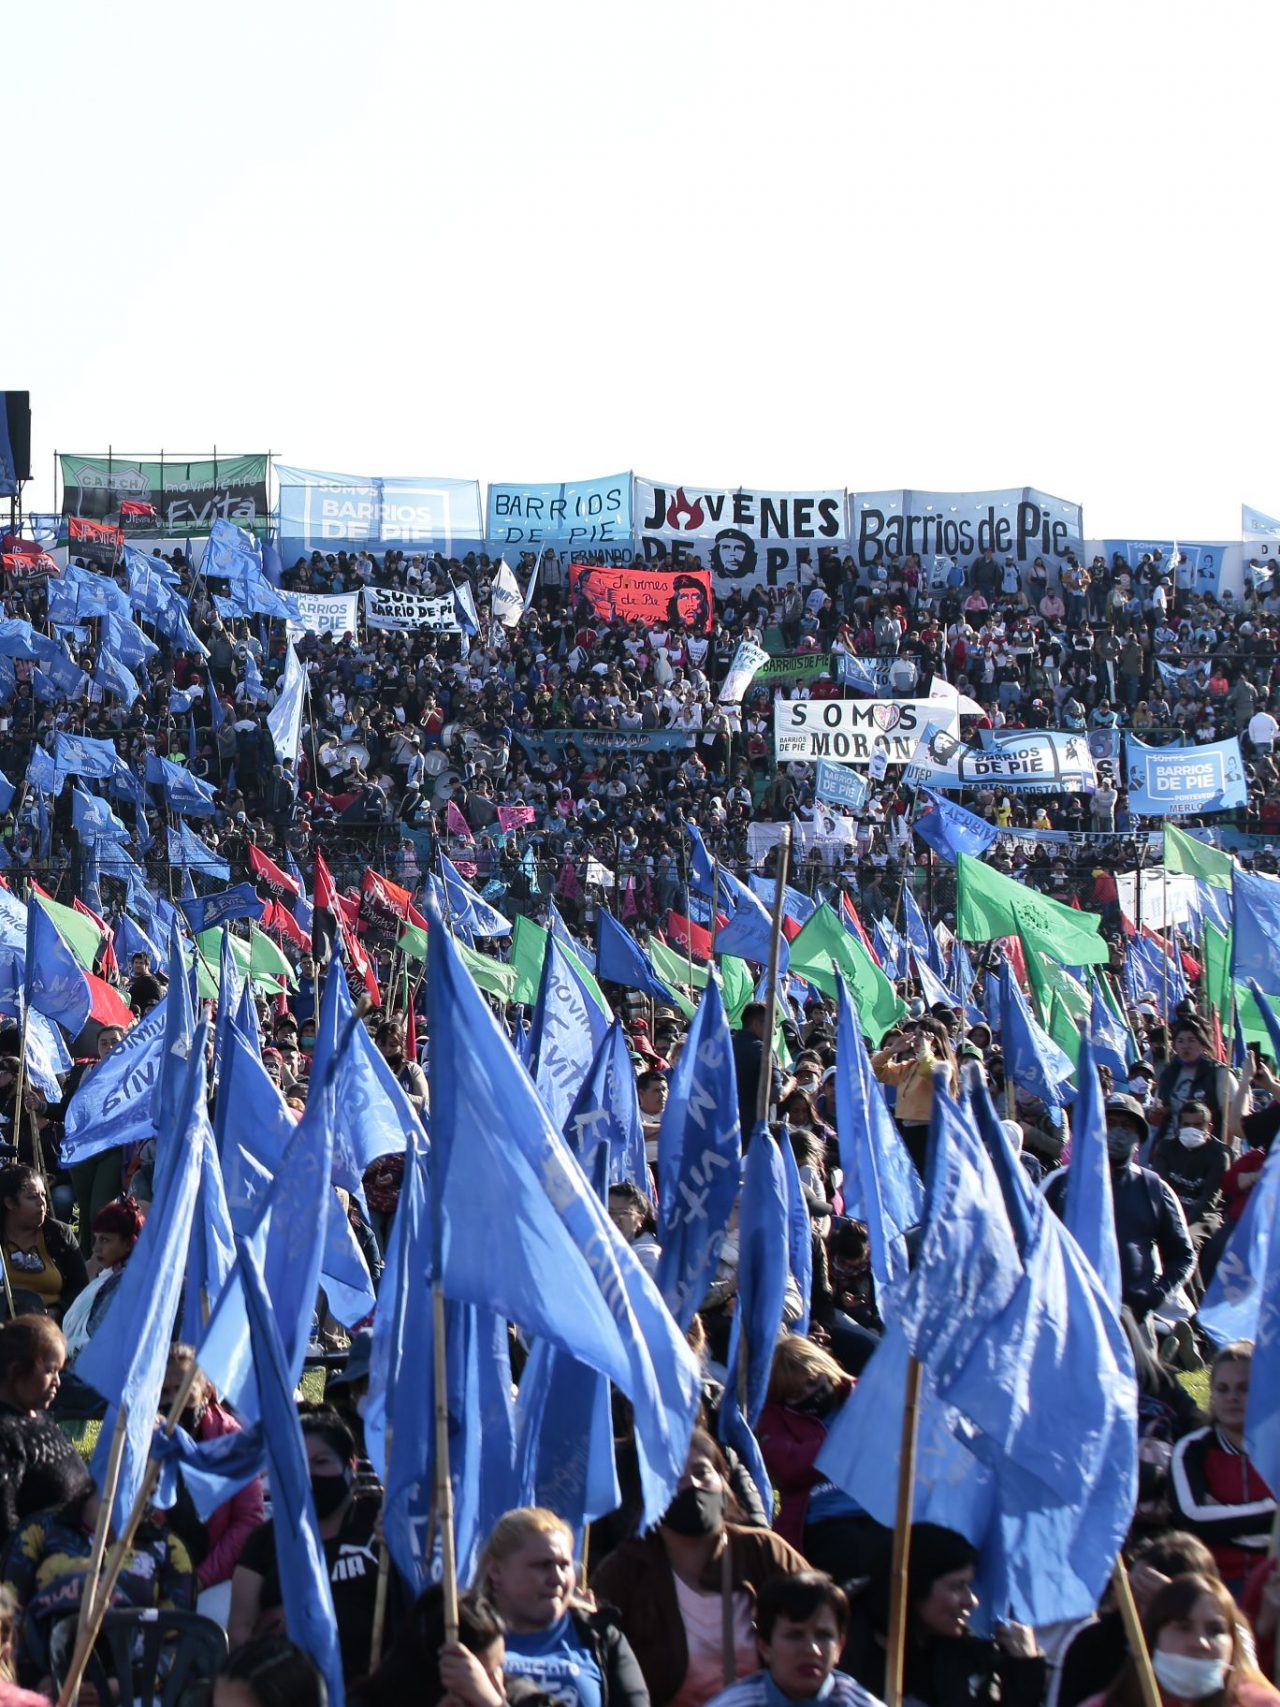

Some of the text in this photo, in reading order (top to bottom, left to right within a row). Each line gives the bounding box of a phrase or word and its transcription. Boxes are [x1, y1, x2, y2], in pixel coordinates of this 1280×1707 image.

[323, 500, 433, 523] BARRIOS
[495, 488, 622, 520] BARRIOS
[322, 517, 433, 544] DE PIE
[505, 521, 617, 545] DE PIE
[859, 501, 1070, 567] Barrios de Pie
[642, 536, 695, 565] DE
[419, 603, 435, 618] DE
[318, 615, 347, 630] PIE
[763, 657, 804, 672] BARRIOS
[804, 655, 815, 668] DE
[779, 743, 806, 751] DE PIE
[907, 765, 932, 782] UTEP
[975, 758, 1044, 775] DE PIE
[1156, 763, 1214, 776] BARRIOS
[822, 780, 856, 798] DE PIE
[1156, 774, 1216, 791] DE PIE
[1170, 803, 1205, 813] MERLO
